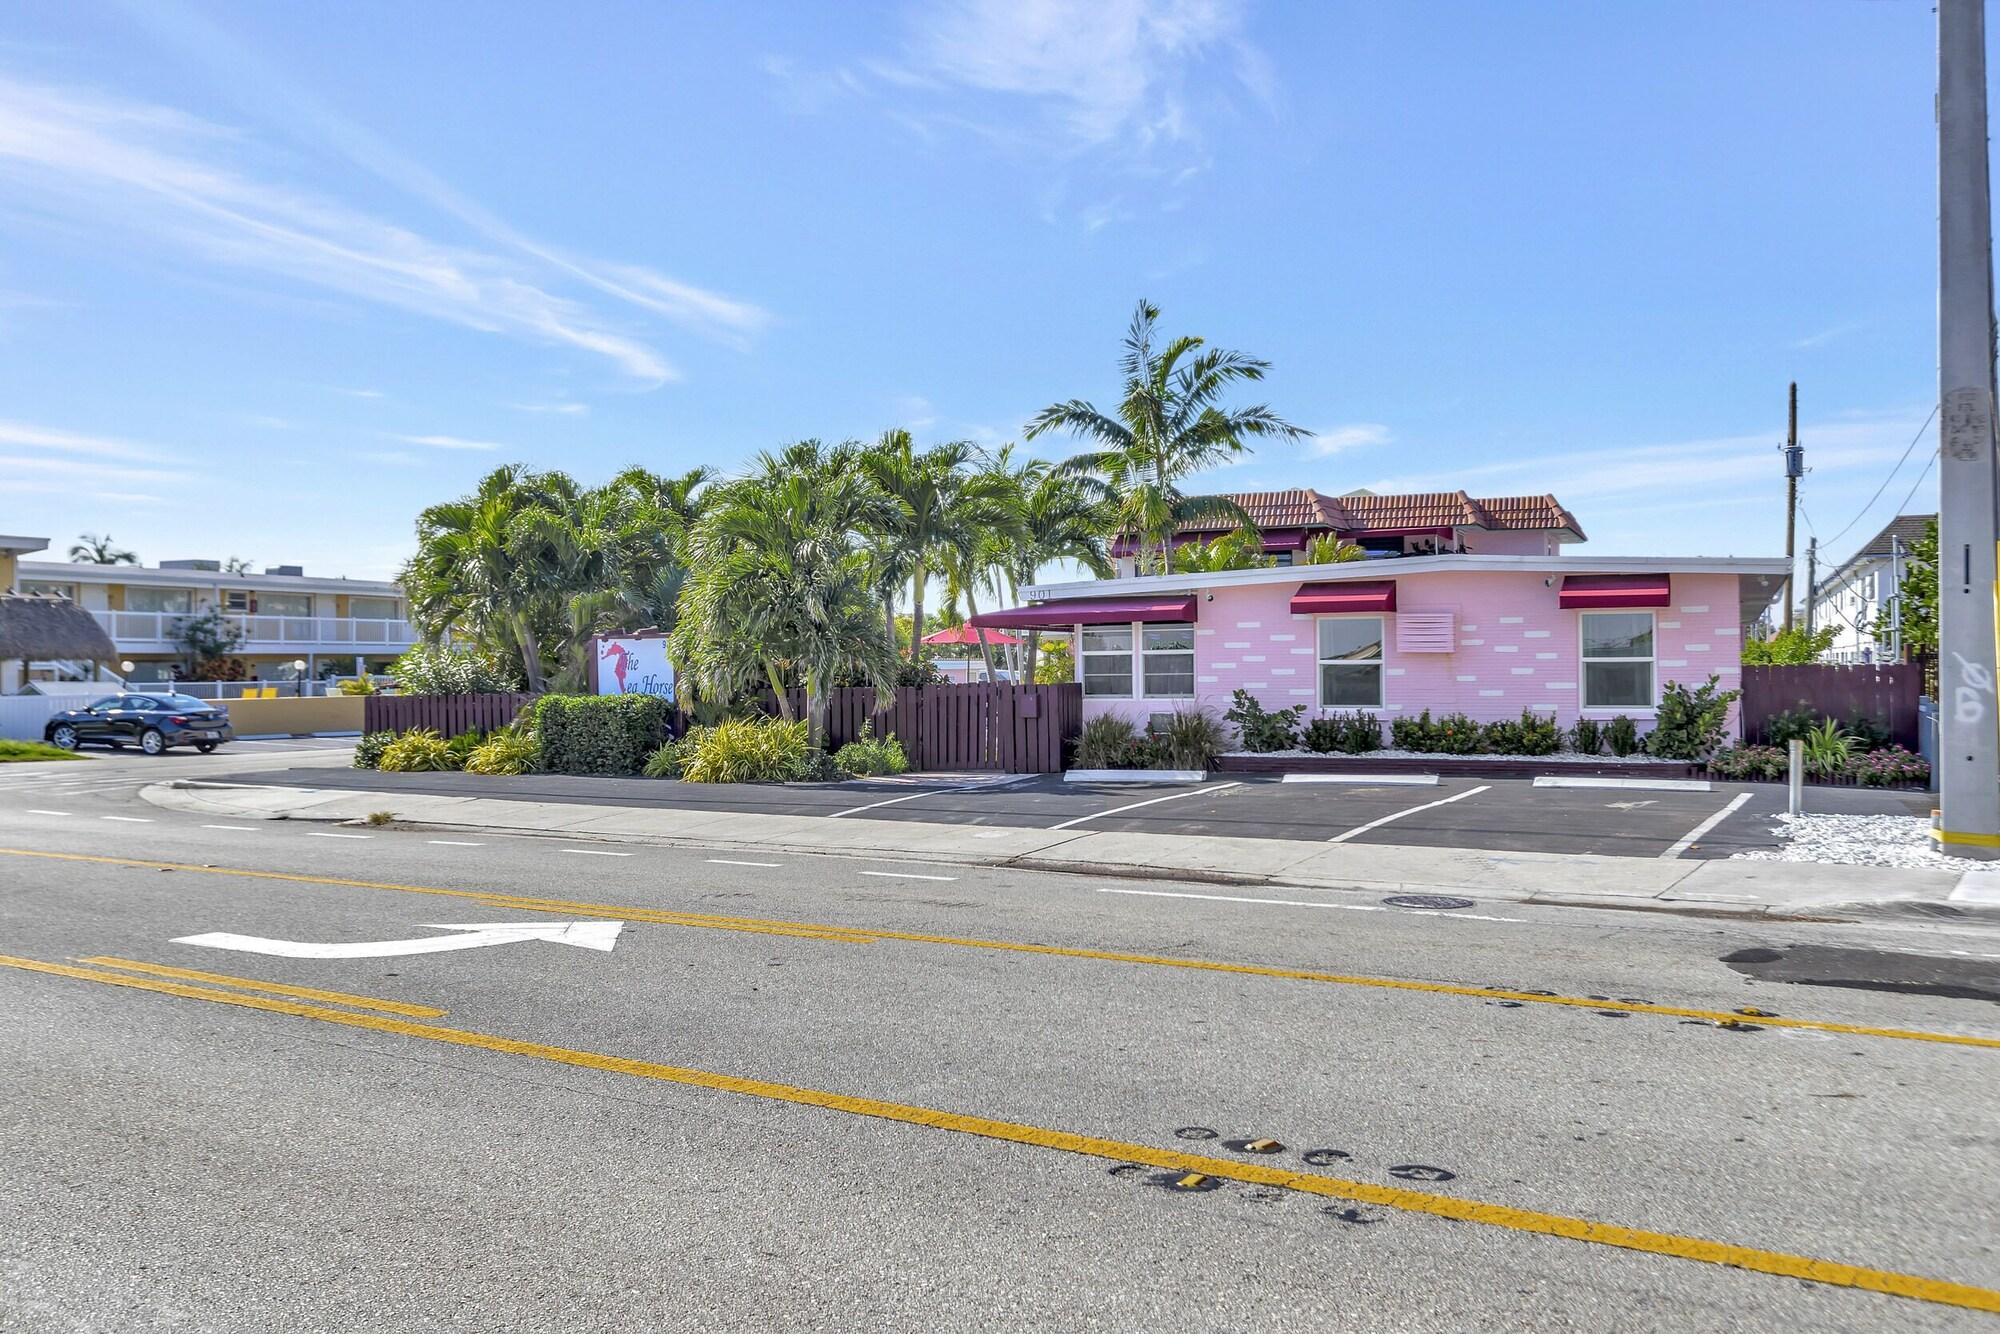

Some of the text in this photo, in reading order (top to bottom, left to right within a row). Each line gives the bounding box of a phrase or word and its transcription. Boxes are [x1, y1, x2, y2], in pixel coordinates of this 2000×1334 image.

[1029, 590, 1051, 599] 901
[621, 651, 639, 671] The
[641, 674, 674, 695] Horse
